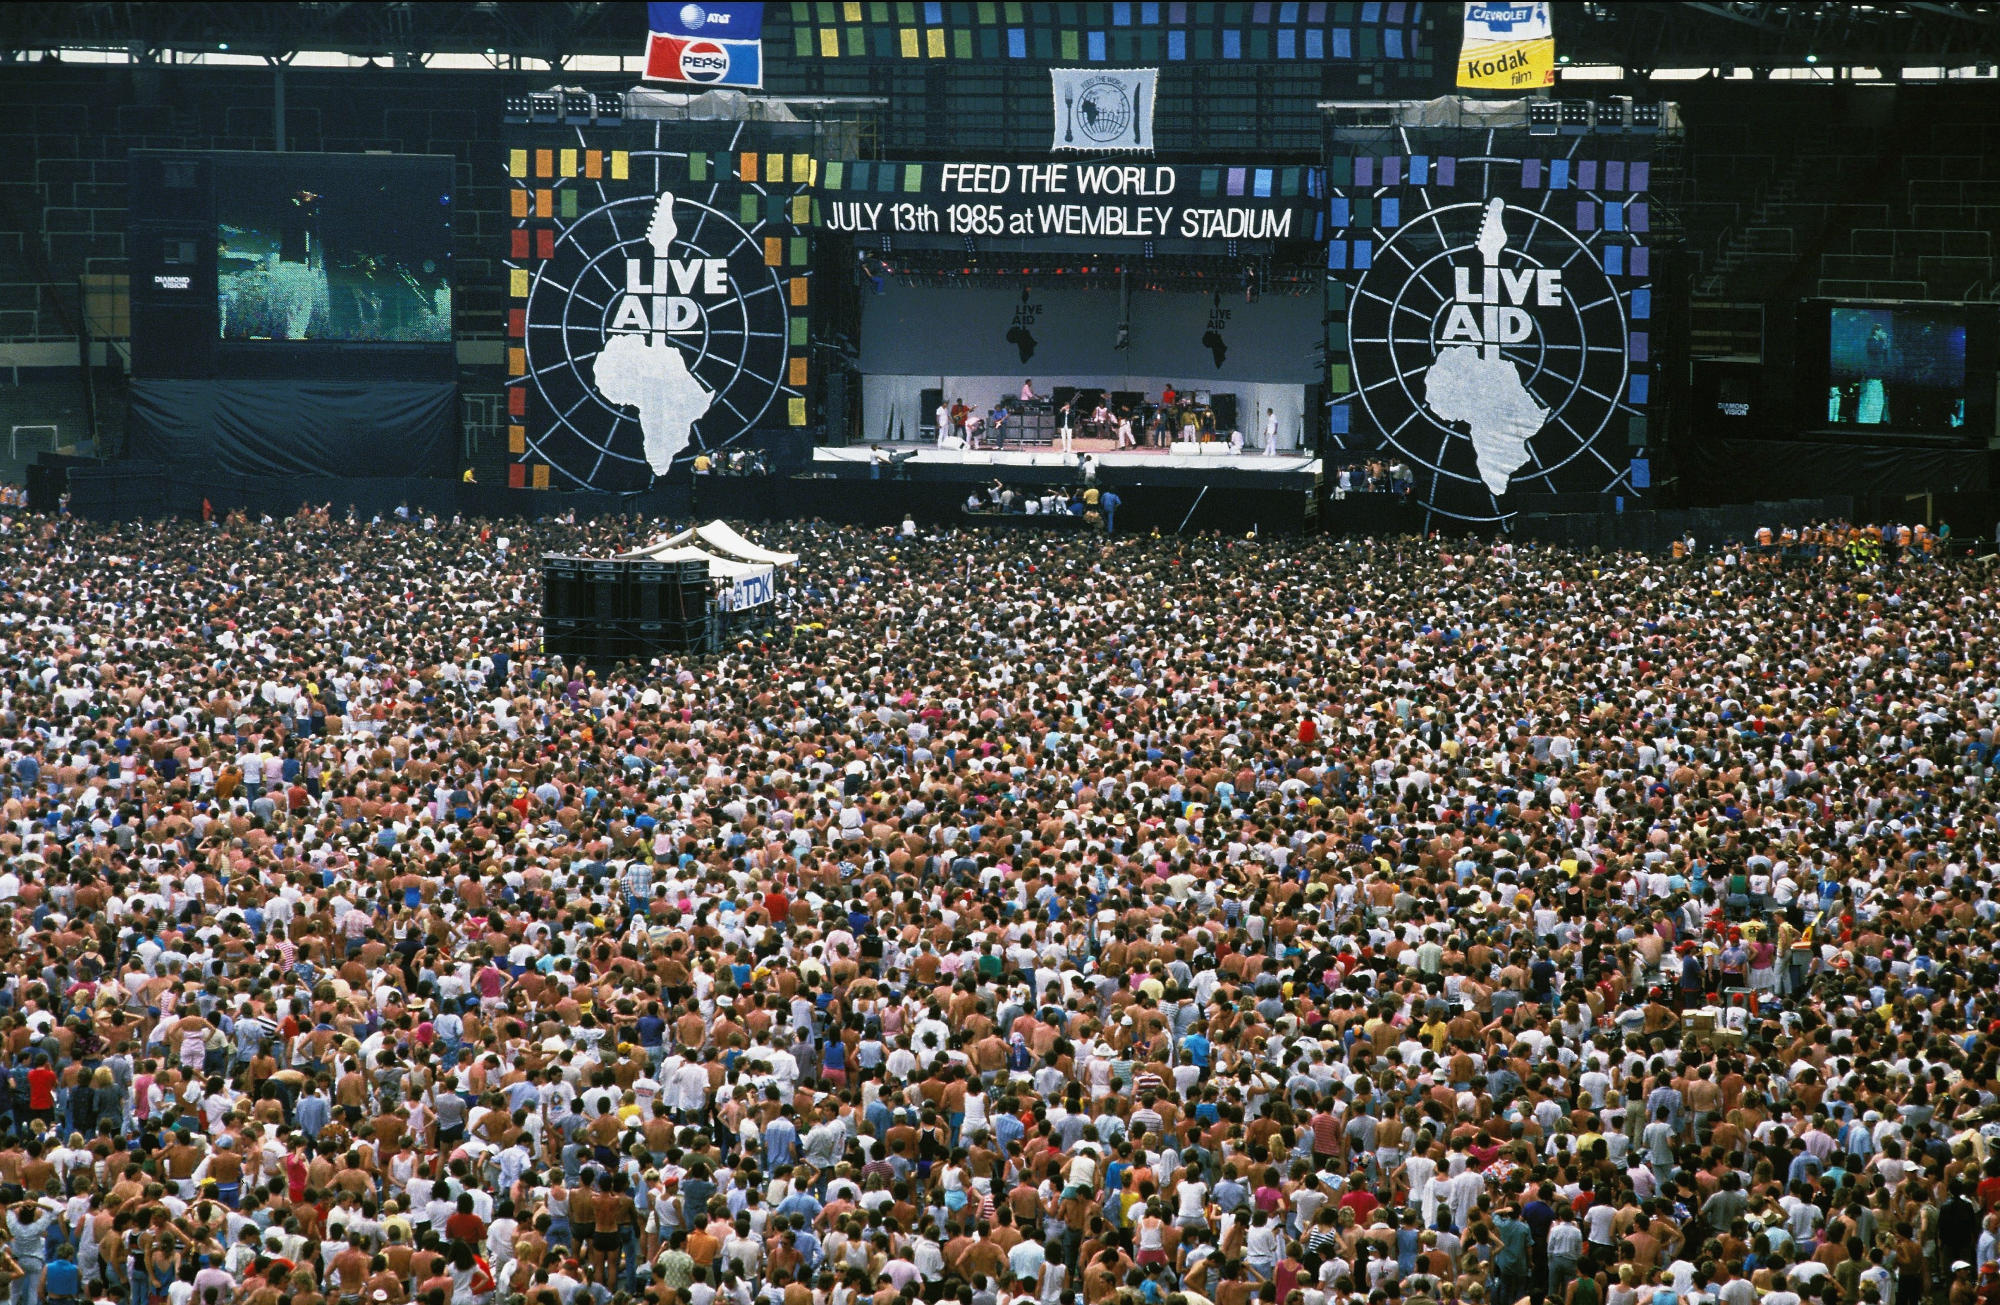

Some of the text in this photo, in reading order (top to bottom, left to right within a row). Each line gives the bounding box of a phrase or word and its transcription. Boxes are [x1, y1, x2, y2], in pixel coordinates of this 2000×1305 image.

[706, 13, 731, 24] AT&T
[682, 56, 727, 70] PEPSI
[1468, 50, 1529, 79] Kodak
[1511, 71, 1532, 86] film
[941, 163, 1176, 196] FEED THE WORLD
[826, 201, 1292, 238] JULY 13th 1985 at WEMBLEY STADIUM
[626, 258, 728, 295] LIVE
[1454, 266, 1562, 306] LIVE
[612, 295, 699, 331] AID
[1016, 304, 1043, 315] LIVE
[1209, 309, 1231, 320] LIVE
[1012, 315, 1035, 325] AID
[1207, 320, 1225, 330] AID
[1442, 304, 1533, 343] AID
[1717, 402, 1750, 410] DIAMOND
[1724, 408, 1747, 416] VISION
[742, 572, 771, 606] TDK
